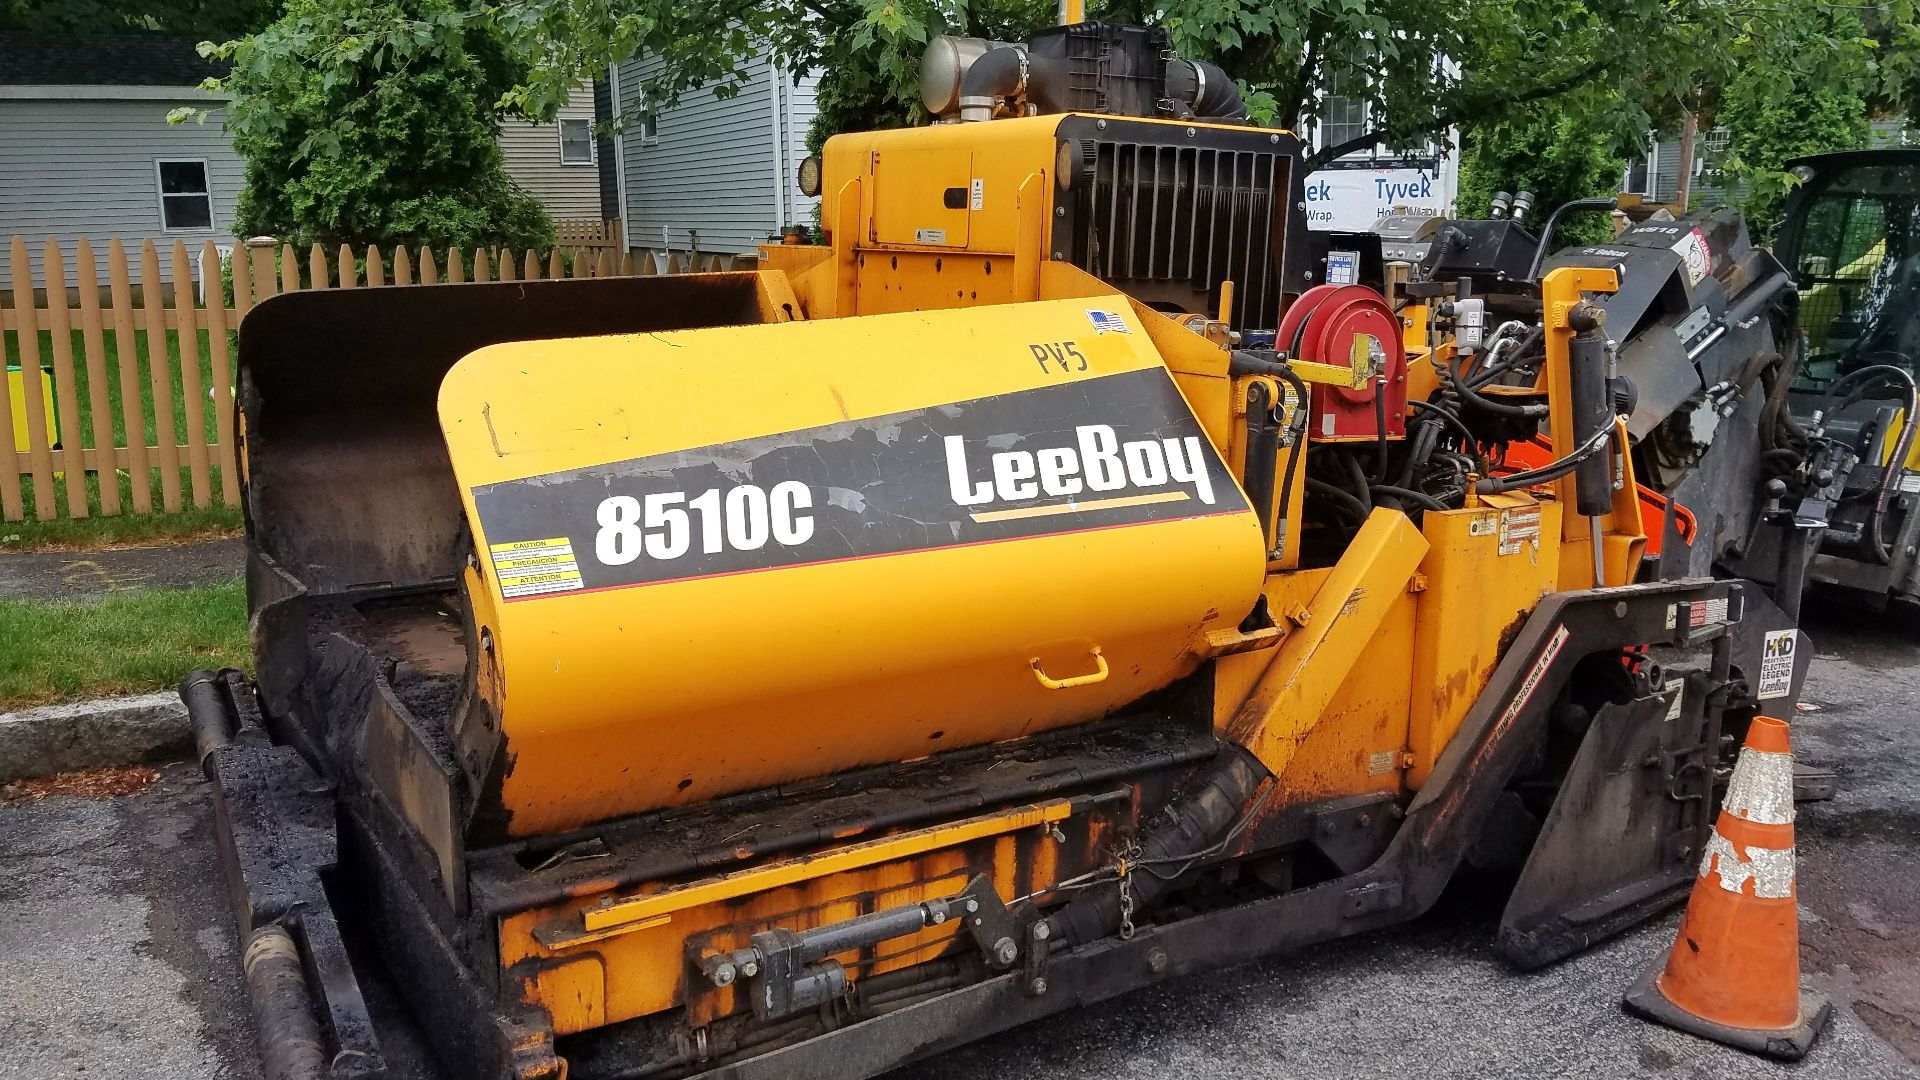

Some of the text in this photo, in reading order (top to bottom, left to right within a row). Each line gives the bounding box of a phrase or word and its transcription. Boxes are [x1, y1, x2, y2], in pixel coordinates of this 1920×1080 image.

[1374, 177, 1431, 205] Tyvek
[1594, 248, 1629, 257] Bobcat
[1699, 241, 1712, 273] DANGER
[1028, 341, 1088, 374] PV5
[943, 424, 1216, 504] LeeBoy
[595, 480, 815, 565] 8510C
[513, 541, 547, 549] CAUTION
[520, 573, 562, 583] ATTENTION
[1762, 669, 1790, 679] LEGEND
[1763, 662, 1792, 671] ELECTRIC
[1513, 662, 1543, 713] PROFESSIONAL
[1760, 679, 1789, 694] LeeBoy
